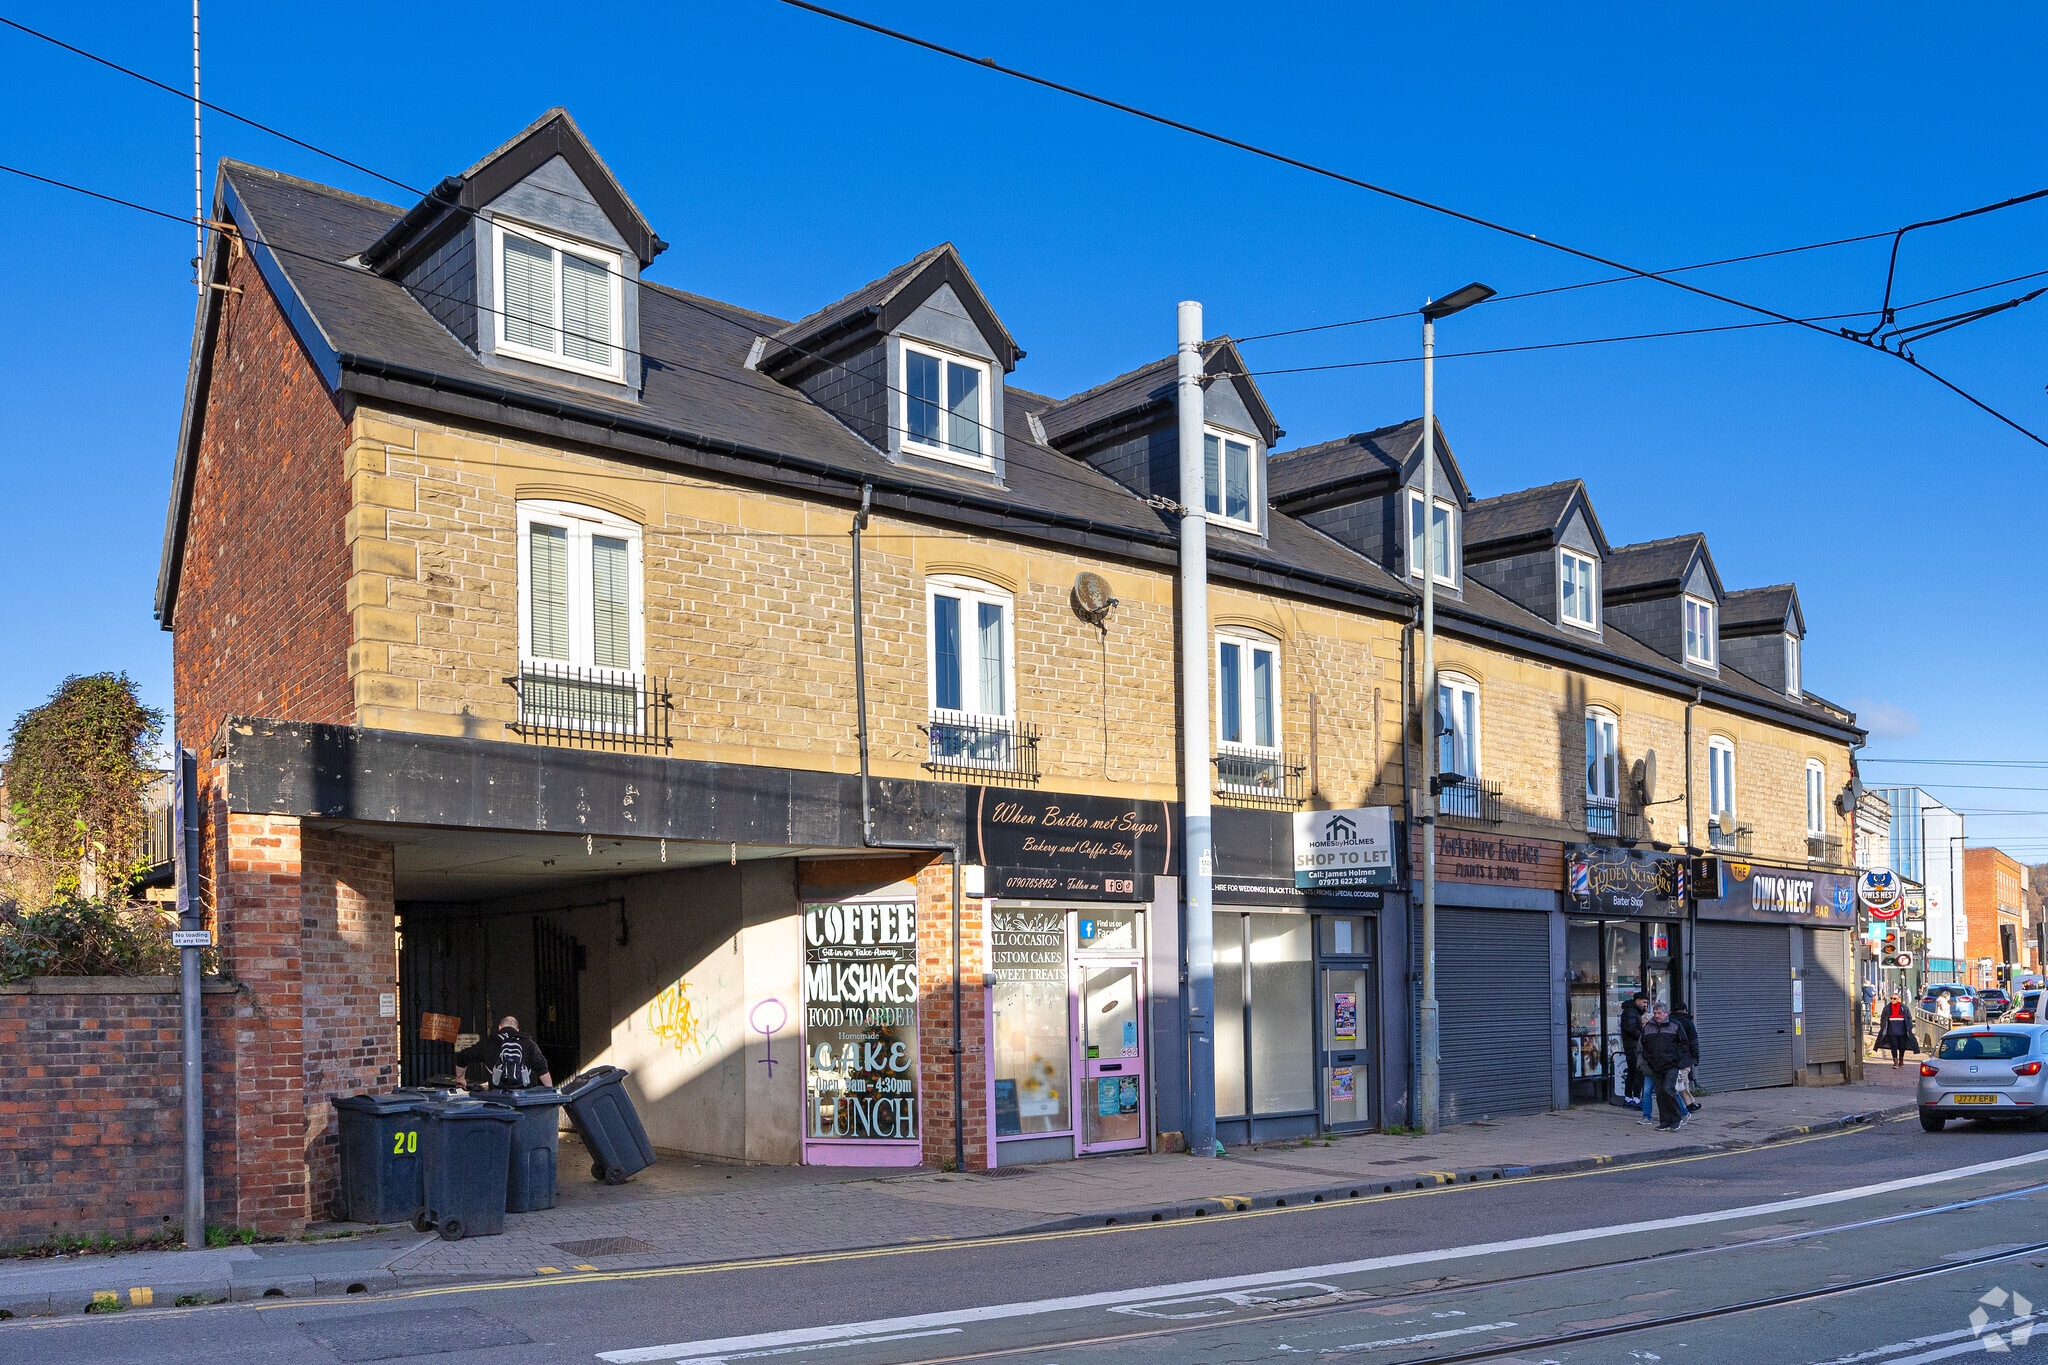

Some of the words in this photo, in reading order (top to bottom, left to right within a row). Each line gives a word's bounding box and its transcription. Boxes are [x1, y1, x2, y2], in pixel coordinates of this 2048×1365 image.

[992, 802, 1036, 824] When
[1041, 805, 1087, 827] Butter
[1089, 815, 1118, 830] met
[1118, 811, 1158, 840] Sugar
[1022, 837, 1058, 857] Bakery
[1058, 841, 1079, 853] and
[1078, 840, 1107, 859] Coffee
[1109, 842, 1133, 859] Shop
[1440, 832, 1495, 860] Yorkshire
[1499, 839, 1539, 864] Exotics
[1297, 853, 1335, 866] SHOP
[1340, 852, 1359, 865] TO
[1363, 850, 1388, 863] LET
[1325, 870, 1347, 879] James
[1734, 866, 1746, 877] THE
[1067, 877, 1089, 890] Follow
[1318, 878, 1339, 886] 07973
[1239, 885, 1266, 893] WEDDINGS
[1752, 875, 1785, 911] OWLS
[1786, 879, 1813, 914] NEST
[1863, 891, 1880, 899] OWLS
[1880, 891, 1895, 899] NEST
[1613, 895, 1630, 906] Barber
[1631, 896, 1644, 908] Shop
[1815, 905, 1829, 917] BAR
[806, 904, 916, 946] COFFEE
[1008, 933, 1060, 946] OCCASION
[822, 948, 834, 956] Sit
[853, 948, 873, 957] Take
[873, 948, 898, 958] Away
[992, 951, 1029, 963] USTOM
[1031, 951, 1062, 963] CAKES
[993, 968, 1028, 981] SWEET
[1028, 968, 1066, 981] TREATS
[805, 963, 917, 1003] MILKSHAKES
[808, 1007, 844, 1027] FOOD
[845, 1007, 863, 1027] TO
[865, 1007, 915, 1026] ORDER
[838, 1032, 880, 1040] Homemade
[814, 1041, 912, 1072] CAKE
[815, 1076, 839, 1093] Open
[875, 1077, 912, 1094] 4:30pm
[812, 1097, 915, 1138] LUNCH
[393, 1131, 417, 1154] 20
